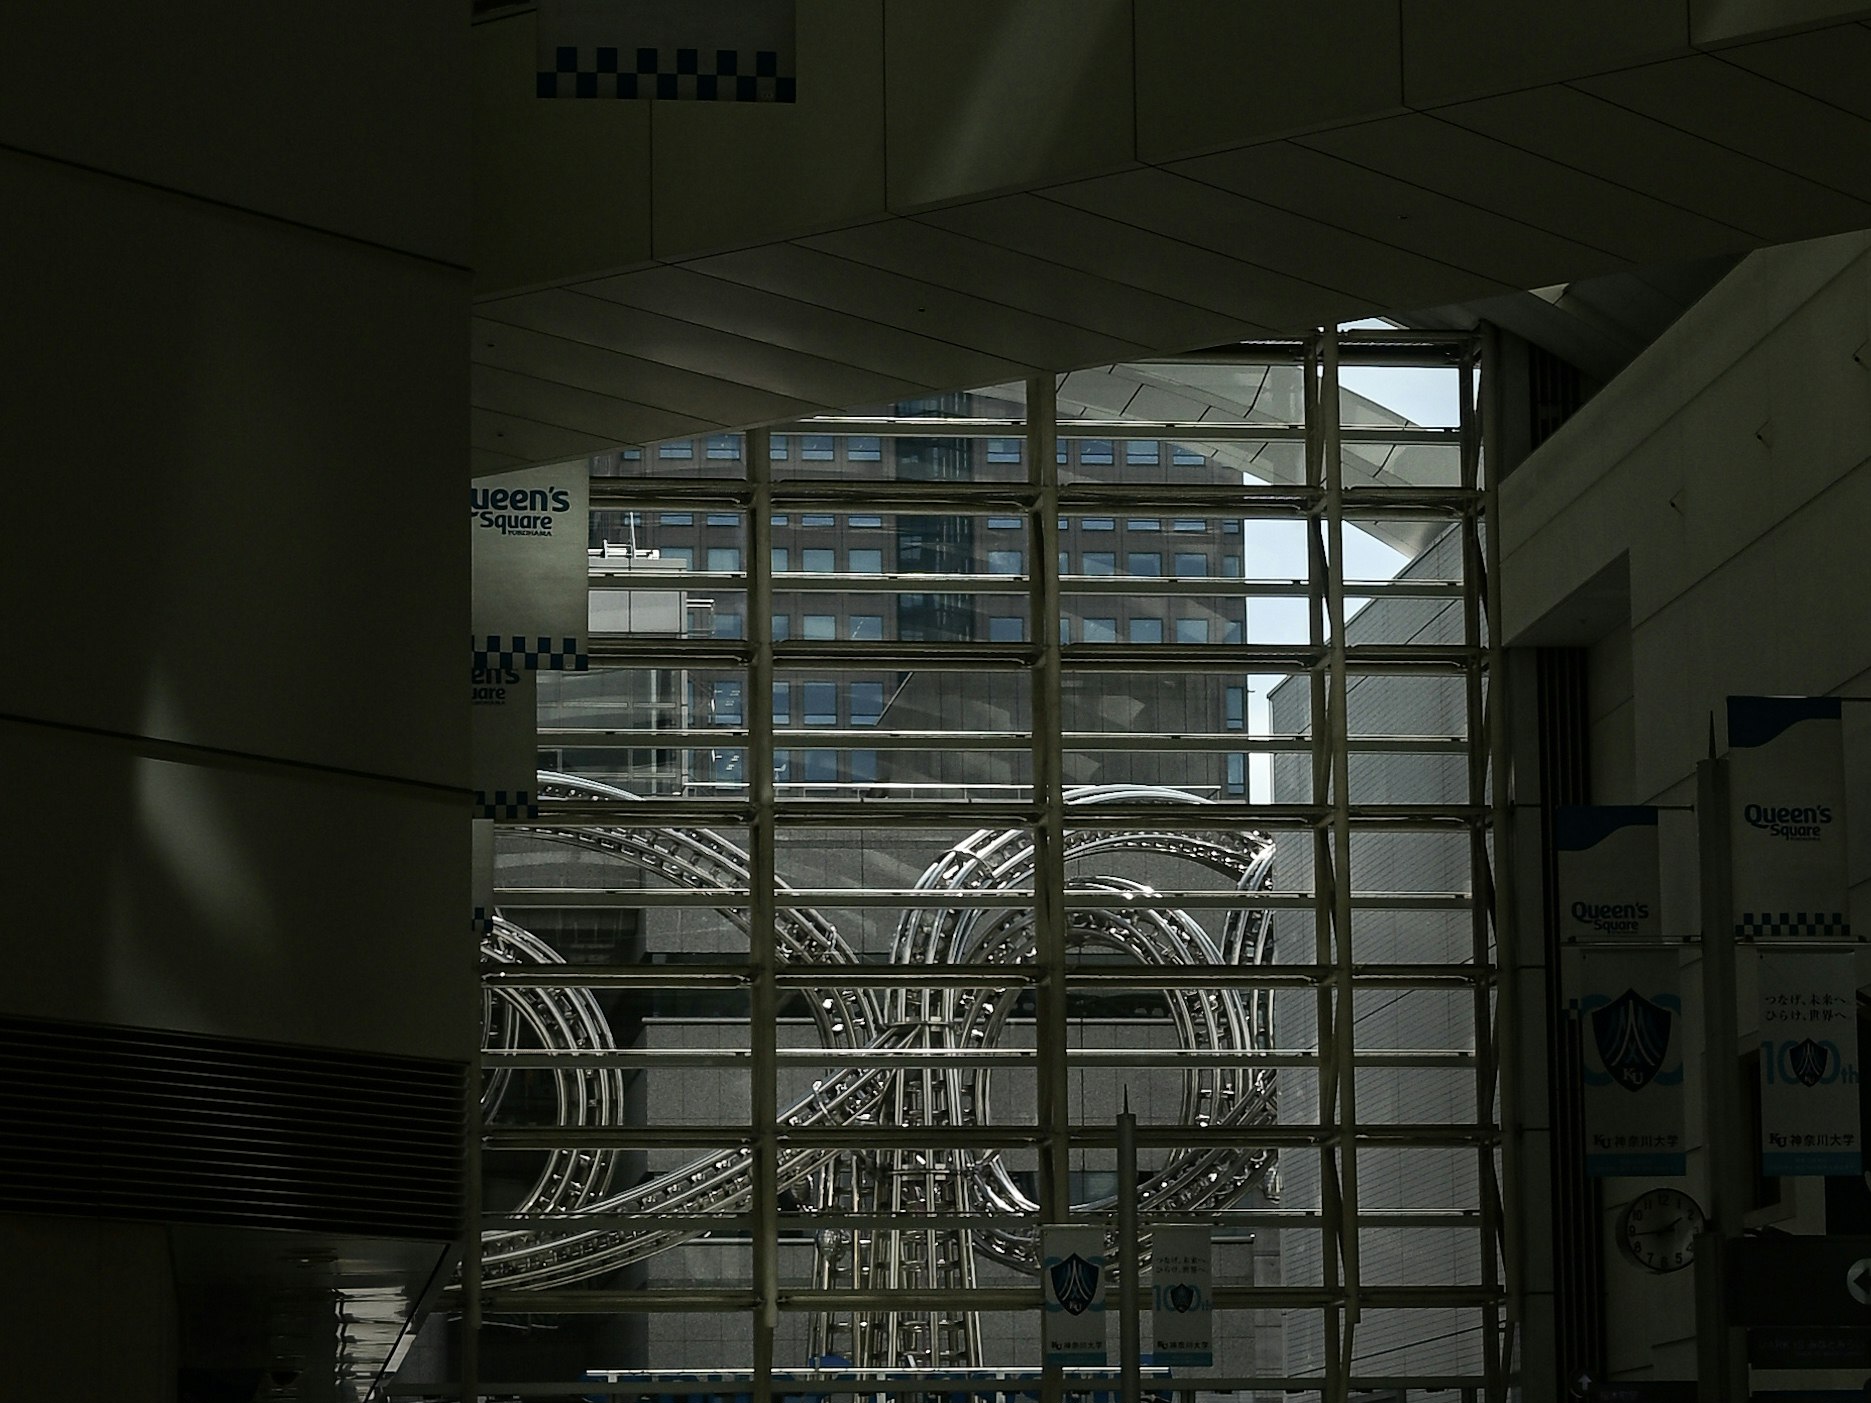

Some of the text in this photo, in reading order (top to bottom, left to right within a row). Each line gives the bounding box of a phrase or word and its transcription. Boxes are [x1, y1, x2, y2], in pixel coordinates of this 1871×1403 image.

[471, 486, 570, 513] ueen's
[479, 511, 553, 535] Square
[1744, 804, 1832, 829] Queen's
[1770, 823, 1821, 841] Square
[1571, 901, 1649, 924] Queen's
[1594, 919, 1639, 934] Square
[1614, 1135, 1679, 1148] 神奈川大学
[1790, 1134, 1854, 1147] 神奈川大学
